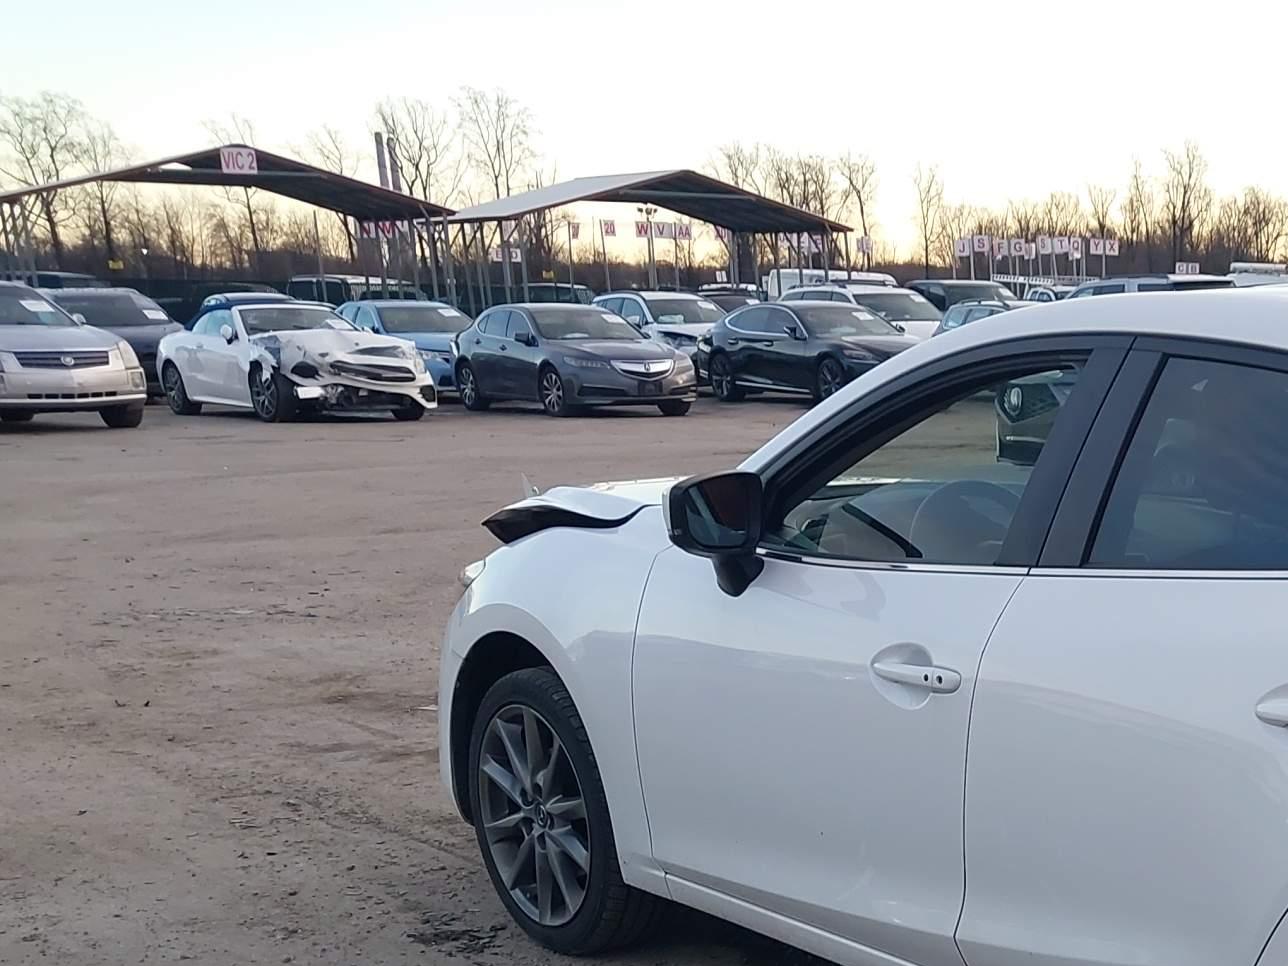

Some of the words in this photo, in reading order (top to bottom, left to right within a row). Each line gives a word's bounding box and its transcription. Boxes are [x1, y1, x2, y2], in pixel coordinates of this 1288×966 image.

[222, 151, 244, 170] VIC
[247, 152, 255, 170] 2
[604, 223, 615, 234] 20
[637, 223, 648, 235] W
[656, 224, 664, 235] V
[679, 225, 690, 237] AA
[959, 243, 966, 253] J
[978, 238, 985, 249] S
[998, 243, 1004, 254] F
[1014, 242, 1022, 252] G
[1058, 240, 1064, 249] T
[1093, 240, 1100, 251] Y
[1108, 242, 1115, 252] X
